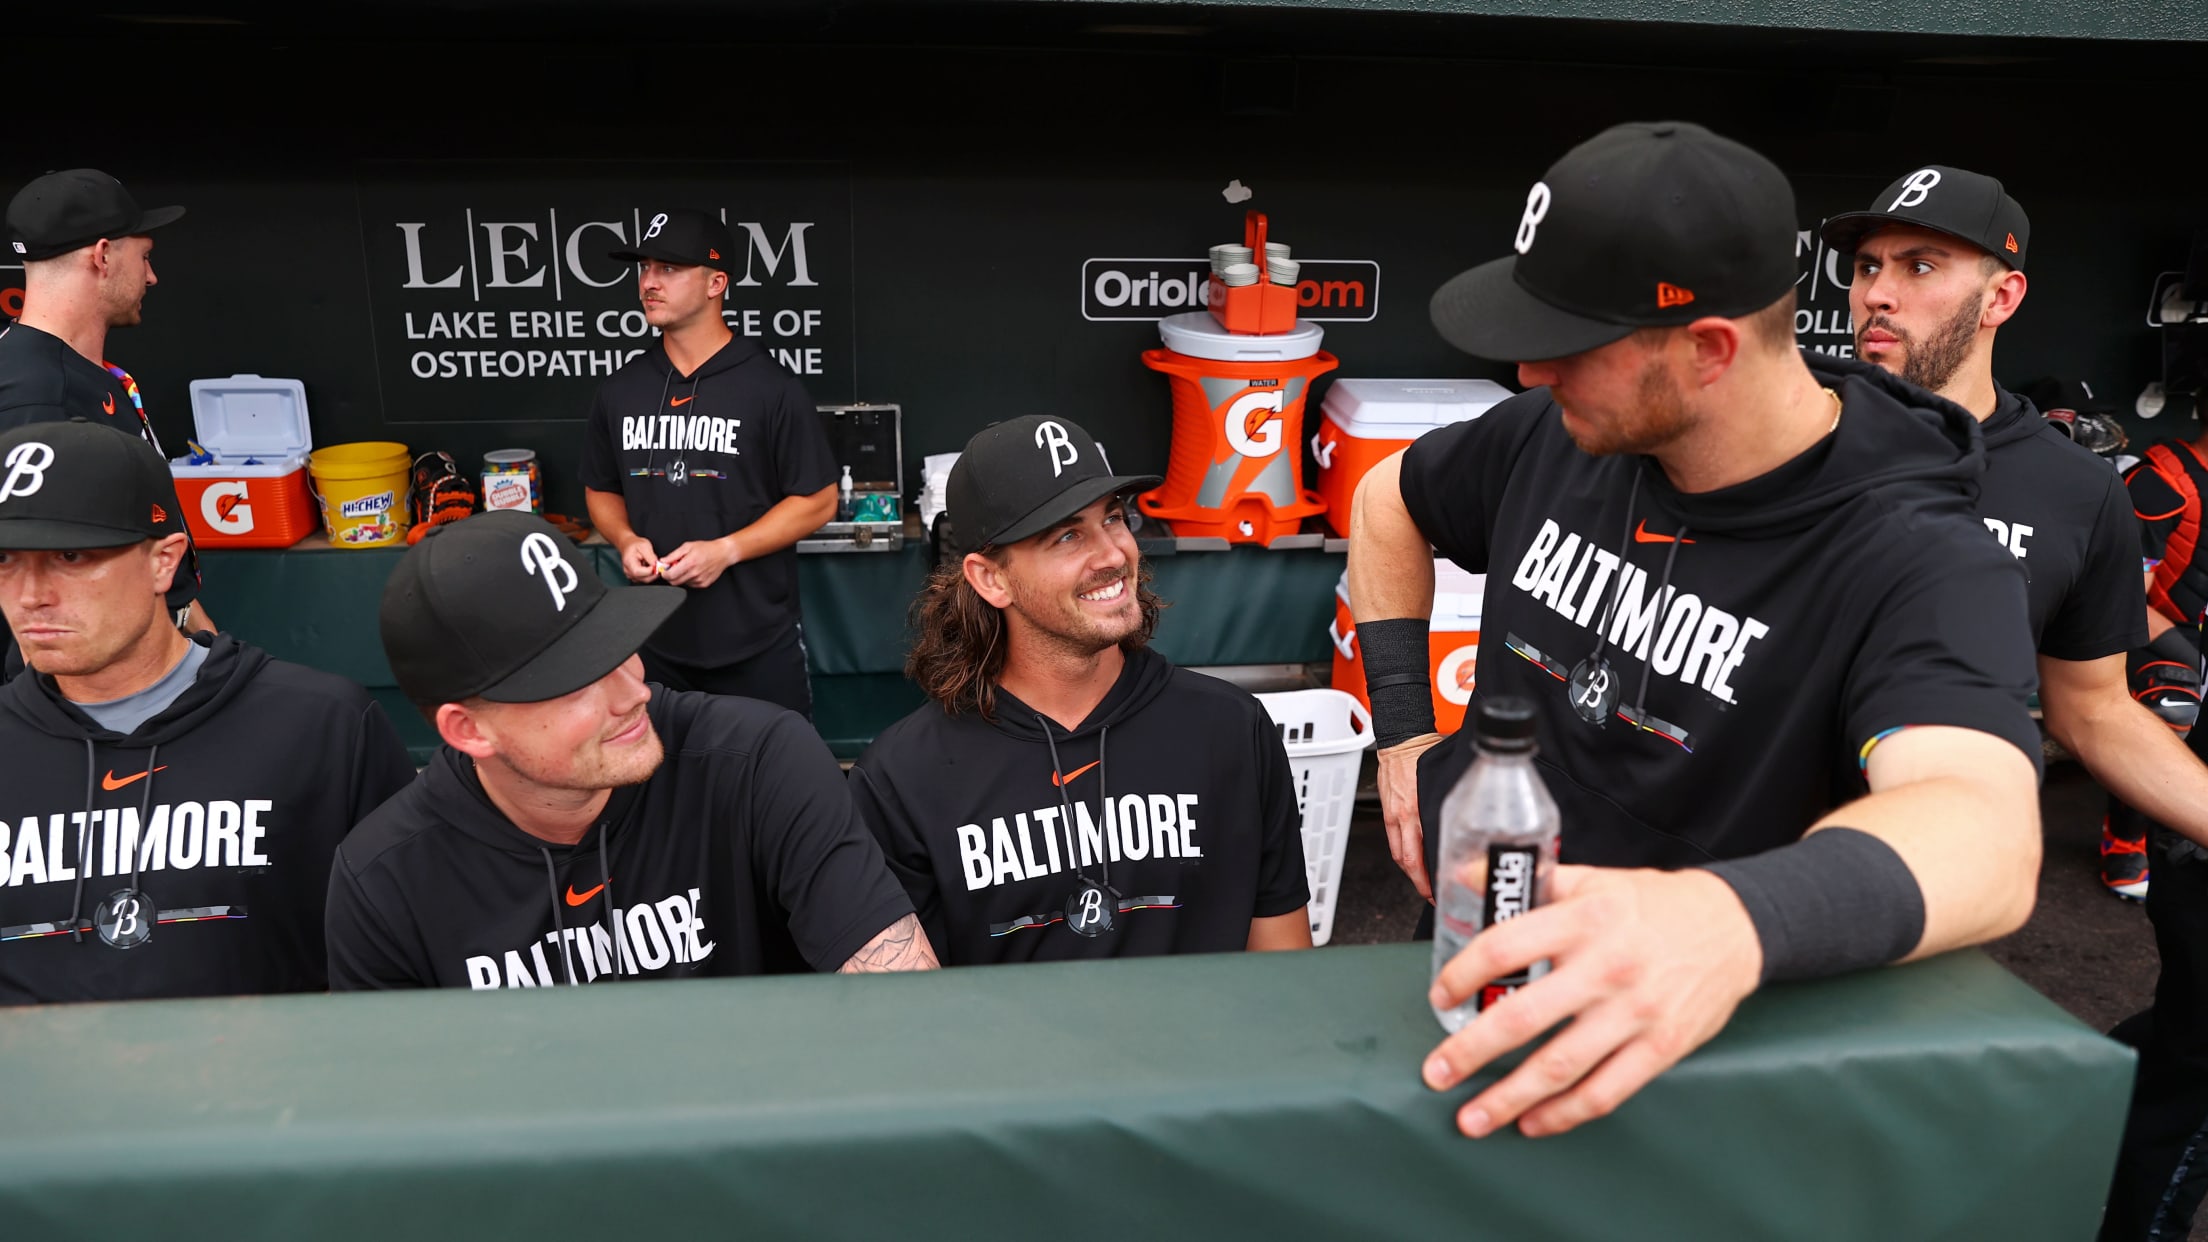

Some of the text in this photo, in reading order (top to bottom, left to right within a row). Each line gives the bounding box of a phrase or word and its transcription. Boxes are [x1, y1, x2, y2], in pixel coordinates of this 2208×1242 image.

[1887, 169, 1941, 212] B
[643, 213, 668, 241] B
[405, 312, 498, 339] LAKE
[509, 311, 585, 338] ERIE
[773, 309, 821, 336] OF
[622, 415, 741, 454] BALTIMORE
[1035, 421, 1078, 478] B
[1224, 389, 1283, 458] G
[0, 442, 55, 503] B
[200, 481, 254, 535] G
[521, 532, 578, 611] B
[1512, 518, 1769, 704] BALTIMORE
[957, 794, 1201, 891] BALTIMORE
